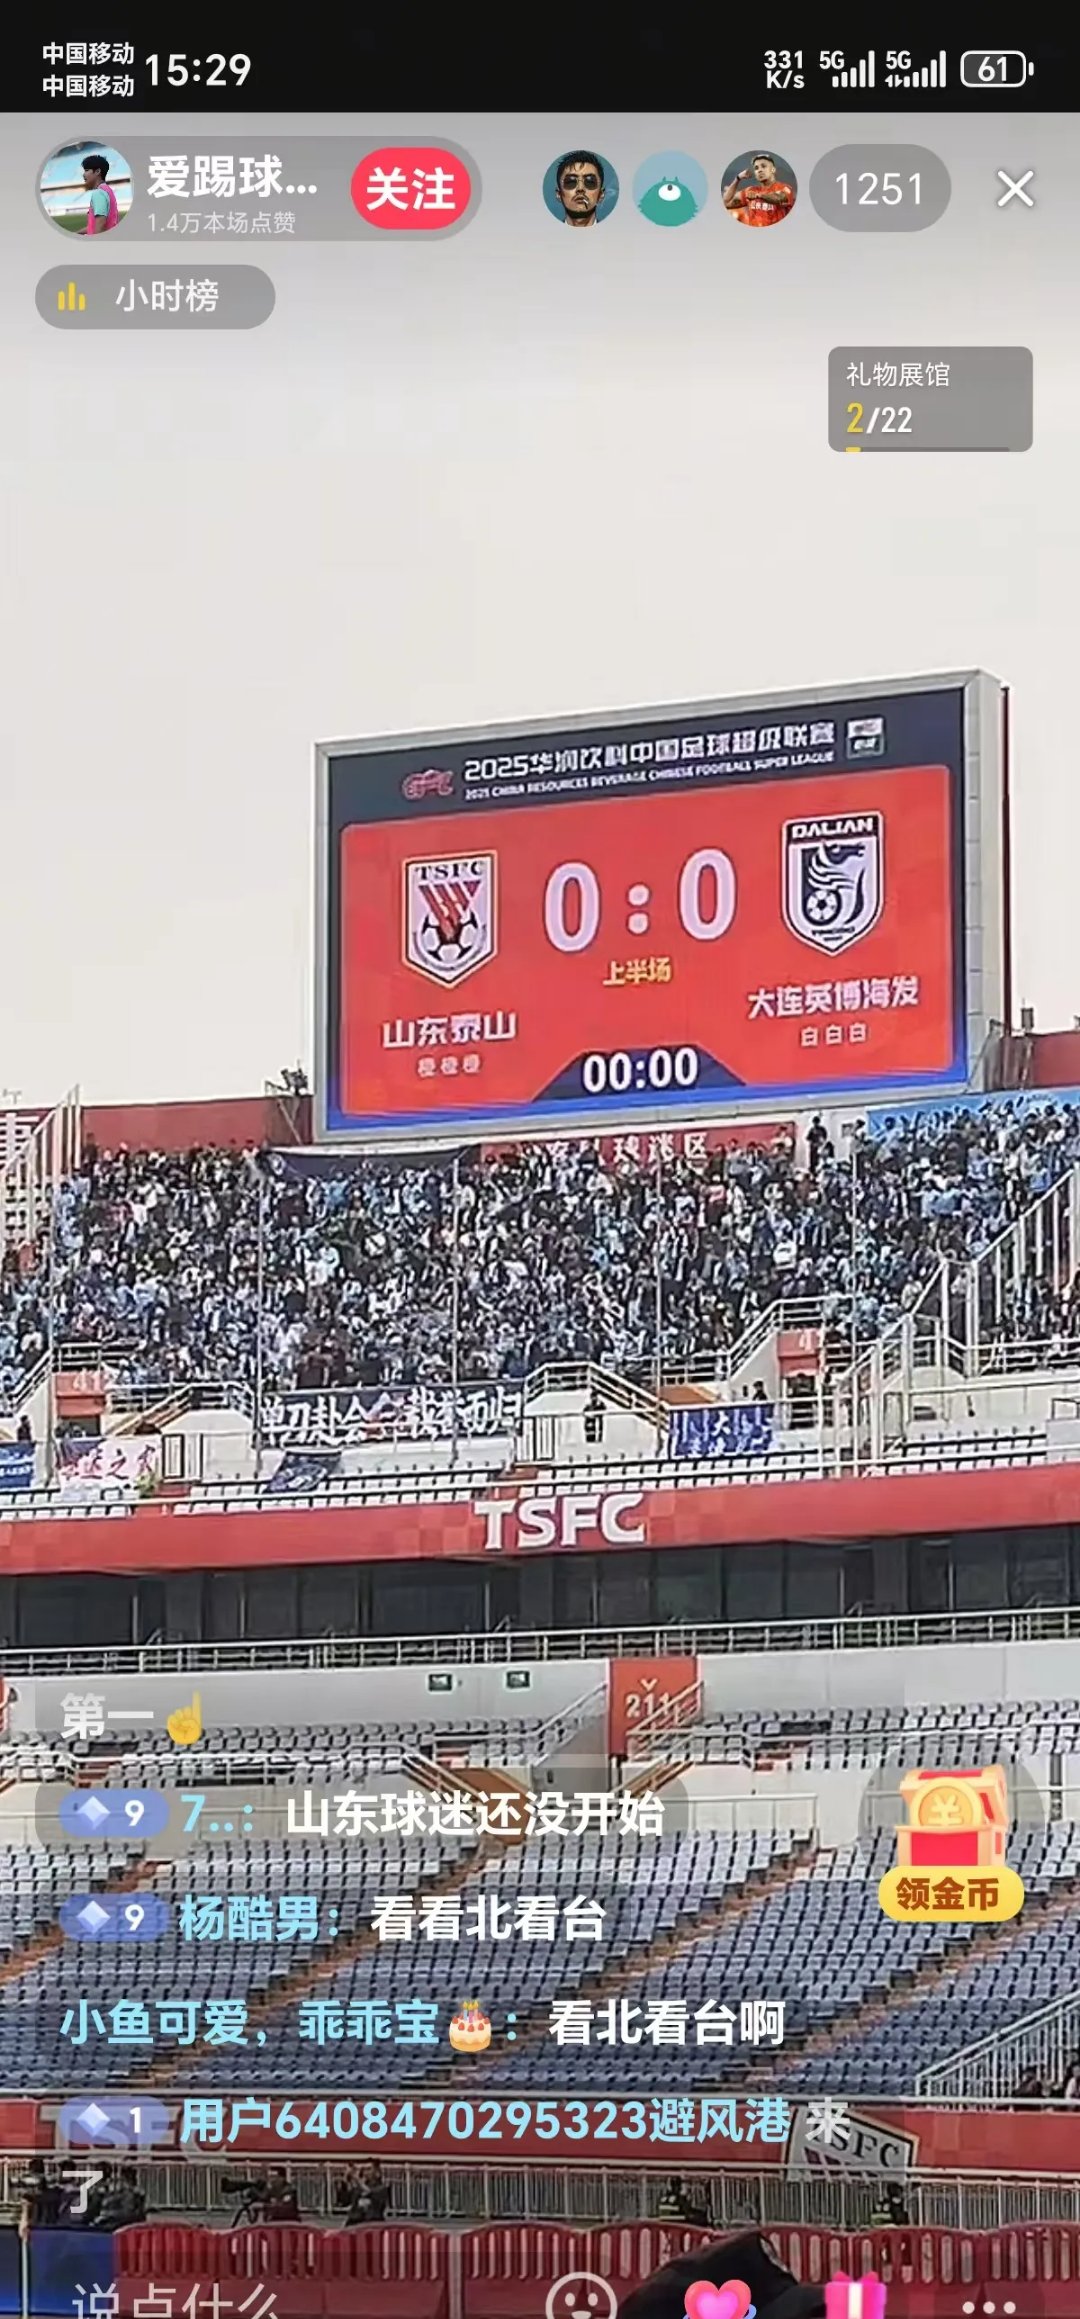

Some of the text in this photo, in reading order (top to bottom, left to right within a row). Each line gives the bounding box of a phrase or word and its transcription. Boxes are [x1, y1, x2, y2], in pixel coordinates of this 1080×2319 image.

[791, 816, 874, 839] DALIAN
[414, 861, 486, 881] TSFC
[602, 957, 673, 986] 上半场
[747, 975, 919, 1020] 大连英博海发
[382, 1010, 517, 1049] 山东泰山
[582, 1046, 699, 1094] 00:00
[473, 1492, 645, 1550] TSFC
[626, 1692, 670, 1718] 211
